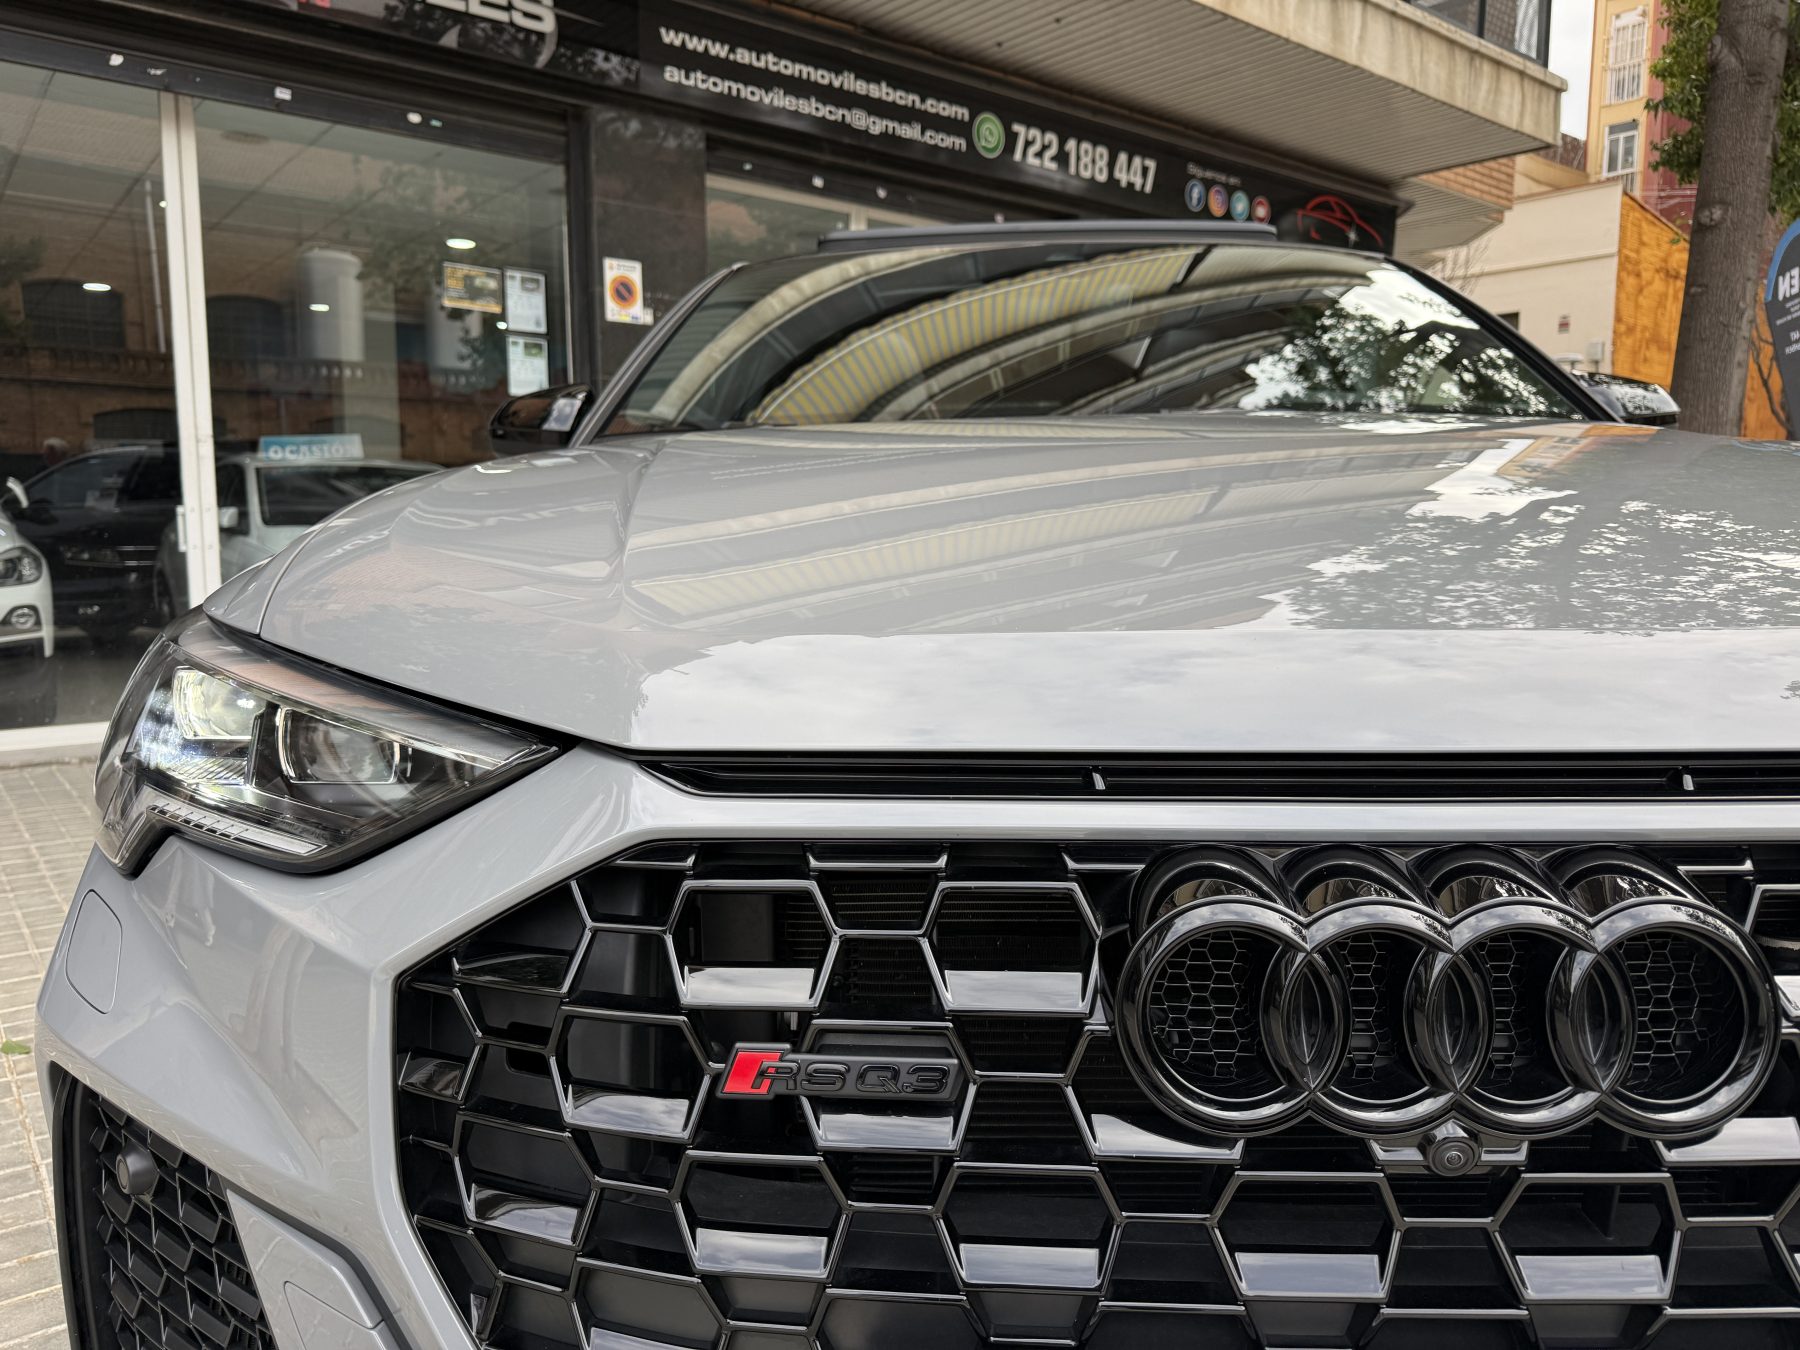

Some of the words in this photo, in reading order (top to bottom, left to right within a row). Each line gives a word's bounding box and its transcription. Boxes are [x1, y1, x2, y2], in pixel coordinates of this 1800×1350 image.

[425, 0, 553, 33] ES
[658, 26, 969, 121] www.automovilesbcn.com
[663, 64, 967, 151] automovilesbcn@gmail.com
[1011, 122, 1060, 171] 722
[1064, 138, 1110, 183] 188
[1112, 150, 1157, 194] 447
[751, 1060, 851, 1091] RS
[855, 1063, 951, 1094] Q3
